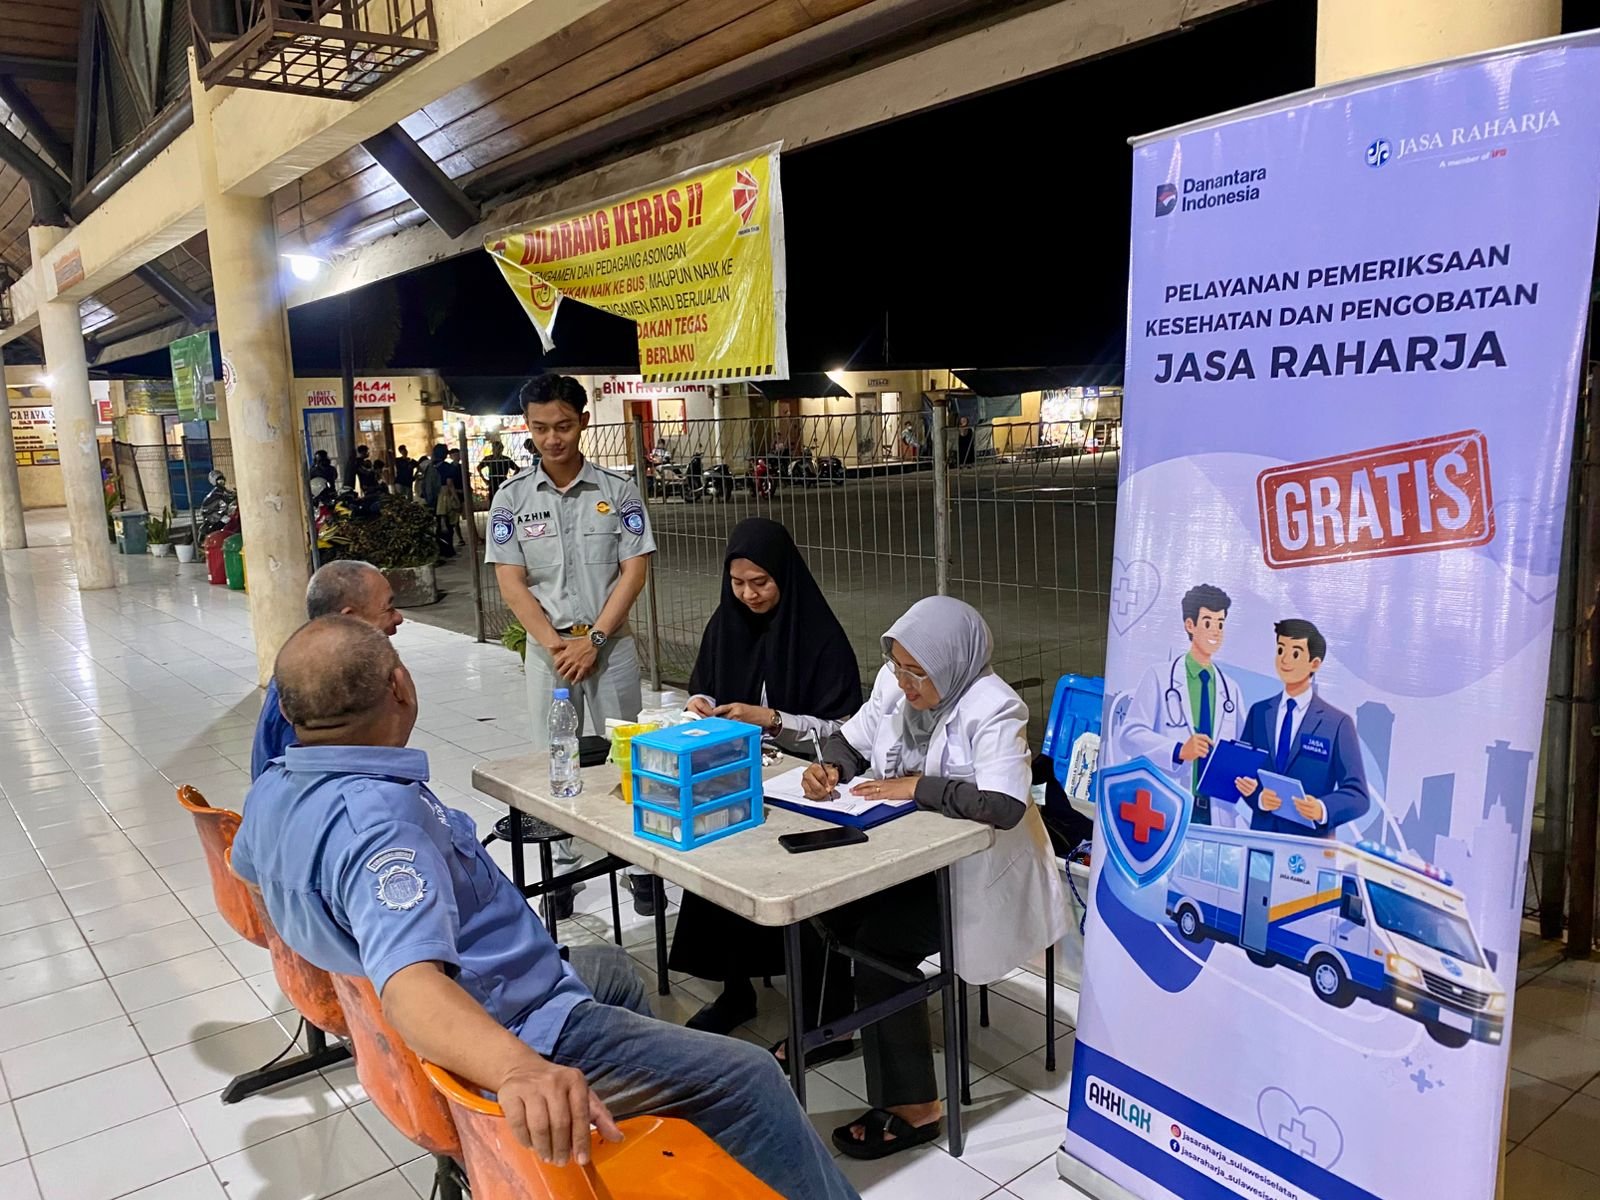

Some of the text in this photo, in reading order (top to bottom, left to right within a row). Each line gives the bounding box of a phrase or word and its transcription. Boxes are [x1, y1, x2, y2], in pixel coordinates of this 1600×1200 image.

[1397, 109, 1561, 159] JASA RAHARJA
[1181, 185, 1260, 212] Indonesia
[1183, 167, 1267, 195] Danantara
[520, 182, 703, 266] DILARANG KERAS !!
[577, 263, 594, 280] DAN
[595, 252, 641, 276] PEDAGANG
[642, 242, 687, 266] ASONGAN
[589, 283, 611, 298] NAIK
[613, 281, 625, 295] KE
[649, 270, 692, 290] MAUPUN
[693, 264, 719, 281] NAIK
[720, 258, 734, 276] KE
[1165, 243, 1511, 303] PELAYANAN PEMERIKSAAN
[651, 295, 675, 312] ATAU
[676, 285, 730, 309] BERJUALAN
[1145, 282, 1539, 337] KESEHATAN DAN PENGOBATAN
[637, 313, 708, 340] DAKAN TEGAS
[646, 343, 695, 365] BERLAKU
[1154, 330, 1507, 384] JASA RAHARJA
[354, 381, 391, 391] ALAM
[354, 393, 396, 403] INDAH
[10, 410, 46, 420] CAHAYA
[517, 510, 551, 525] AZHIM
[1275, 452, 1472, 551] GRATIS
[1089, 1082, 1152, 1134] AKHLAK
[1182, 1131, 1298, 1200] jasaraharja_sulawesiselatan
